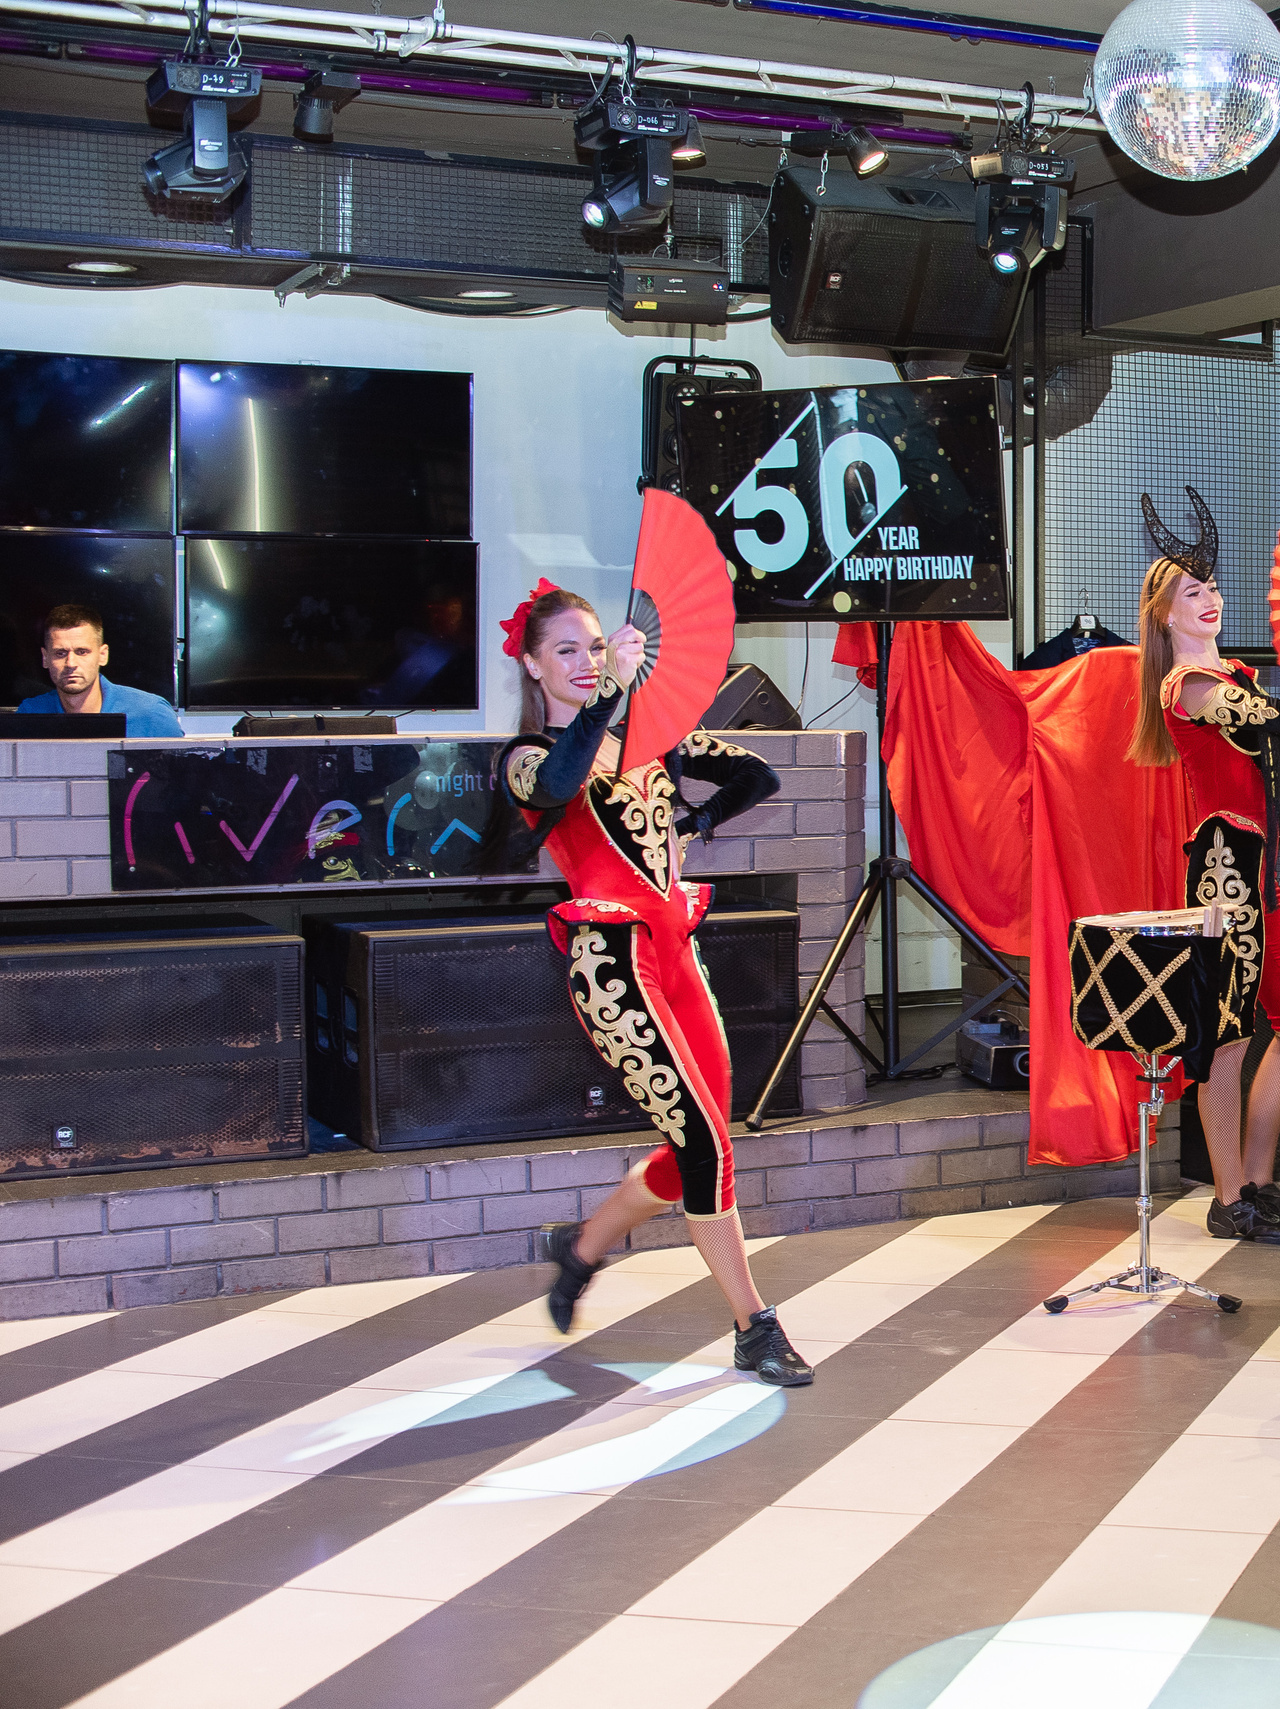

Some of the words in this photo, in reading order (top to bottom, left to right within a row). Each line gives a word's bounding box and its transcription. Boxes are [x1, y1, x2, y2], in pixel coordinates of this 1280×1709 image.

[734, 432, 903, 573] 50
[877, 526, 920, 551] YEAR
[843, 557, 894, 581] HAPPY
[896, 555, 974, 580] BIRTHDAY
[436, 769, 484, 798] night
[58, 1130, 73, 1138] RCF
